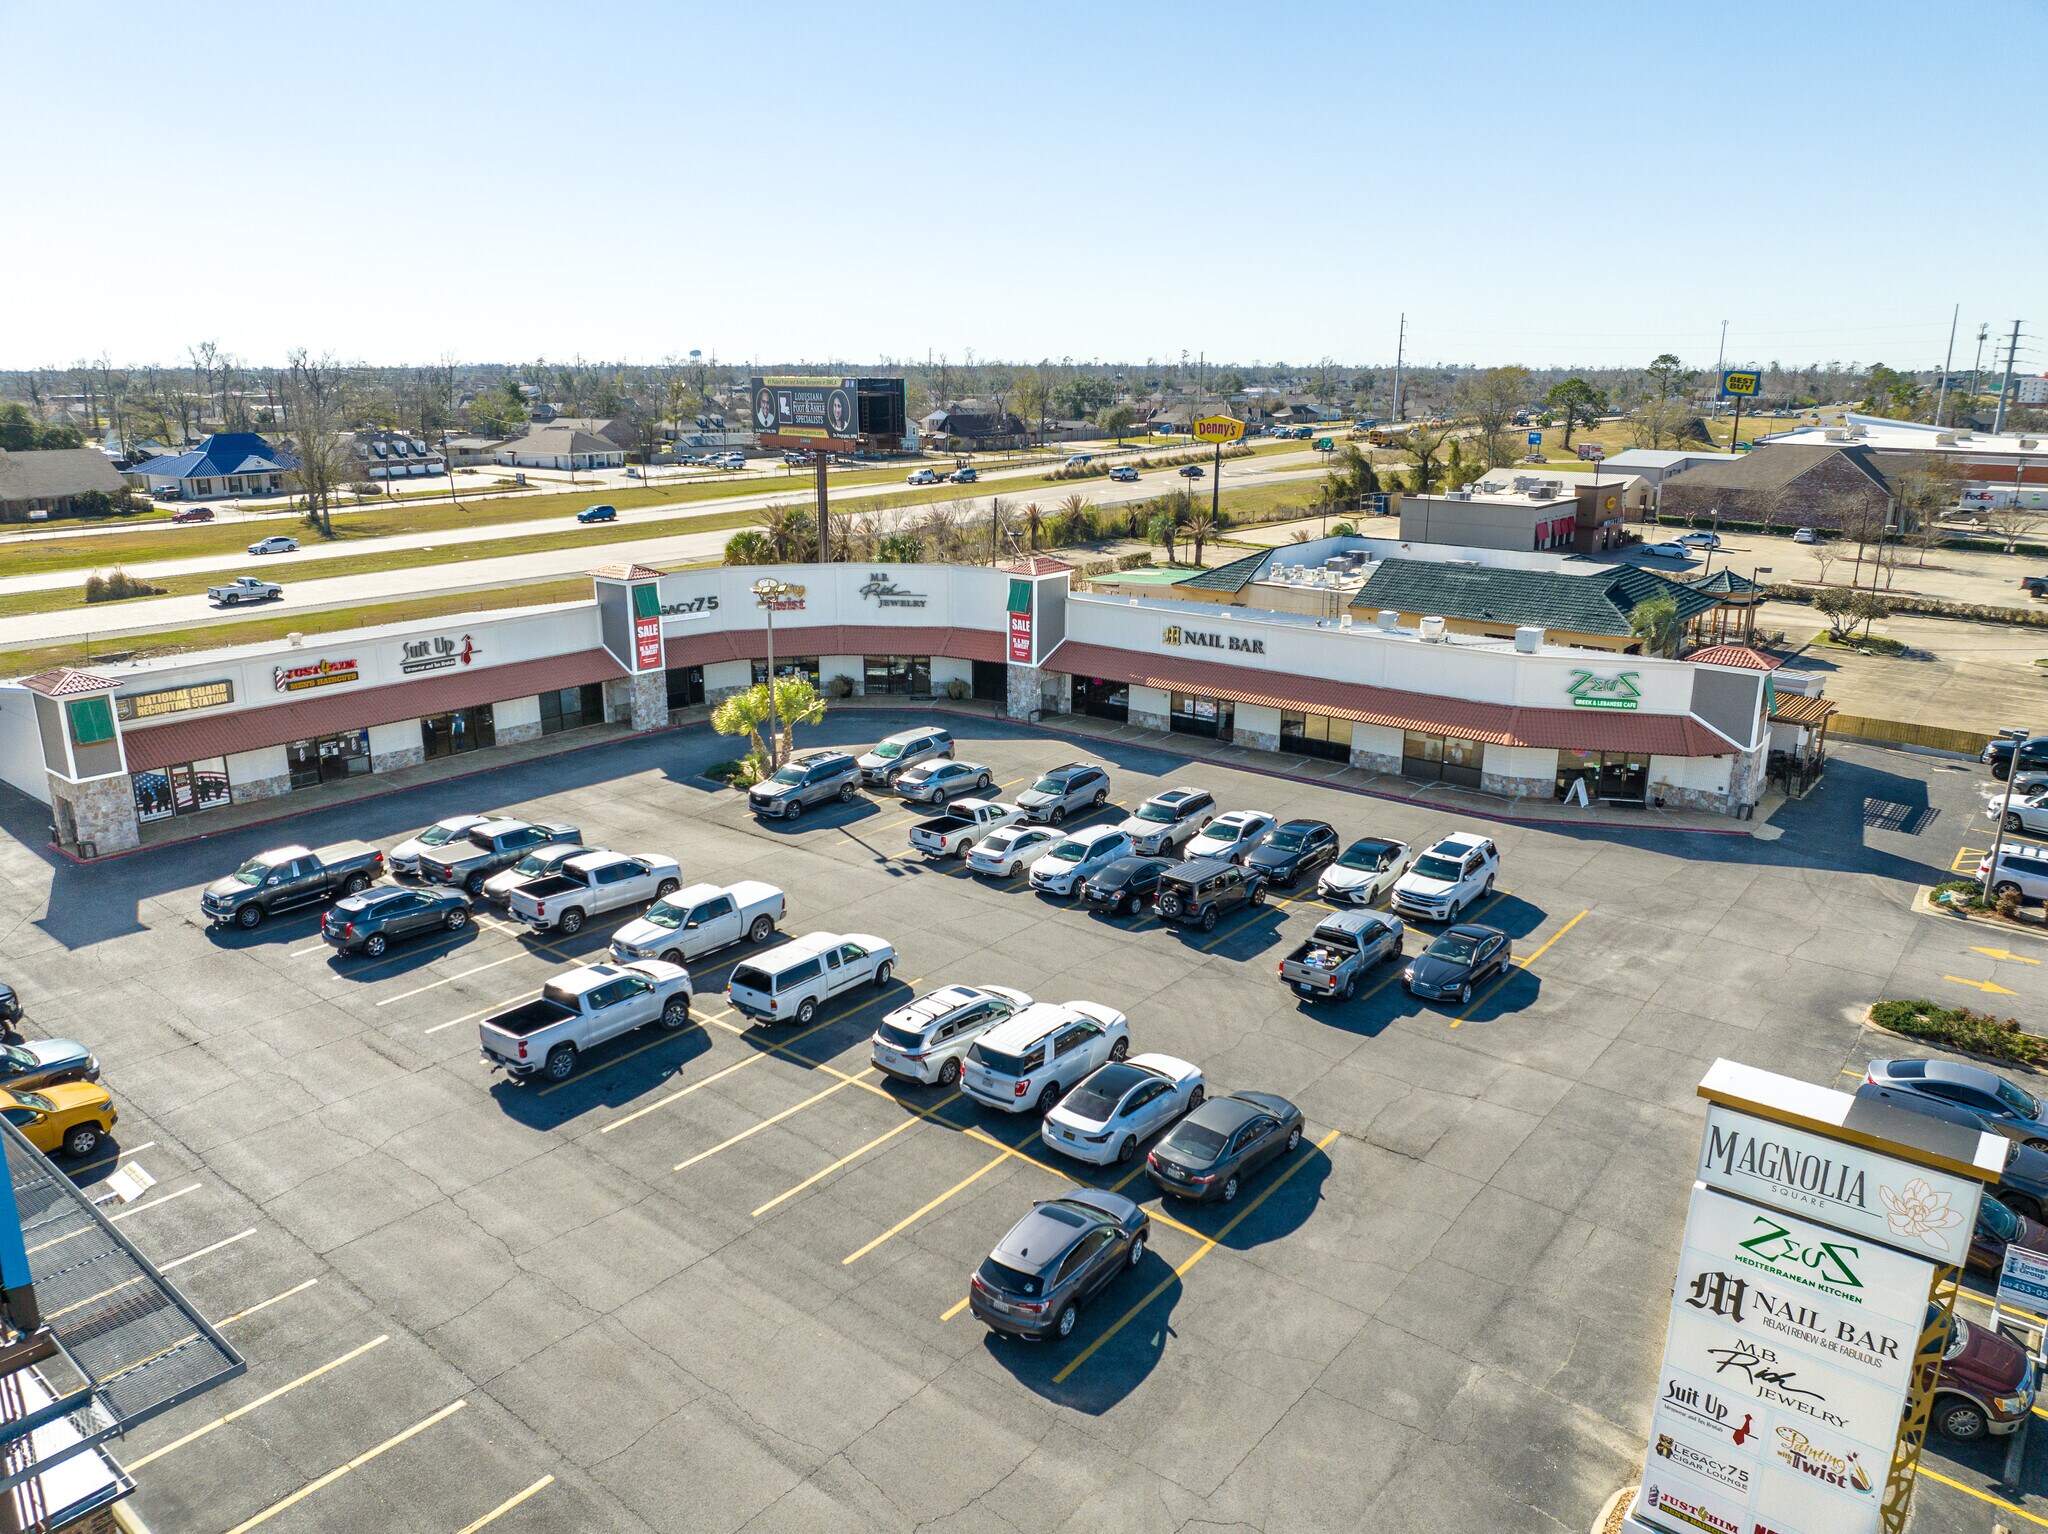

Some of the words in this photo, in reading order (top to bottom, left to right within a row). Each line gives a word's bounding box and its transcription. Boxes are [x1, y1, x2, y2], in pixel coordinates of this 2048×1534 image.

[1730, 376, 1755, 385] BEST
[1730, 383, 1751, 391] BUY
[793, 401, 805, 413] FOOT
[810, 403, 825, 413] ANKLE
[795, 393, 823, 401] LOUISIANA
[795, 415, 824, 424] SPECIALISTS
[1199, 422, 1237, 437] Denny's
[1965, 491, 1994, 501] FedEx
[859, 582, 911, 600] Rich
[878, 599, 927, 609] JEWELRY
[637, 623, 658, 638] SALE
[1012, 618, 1031, 632] SALE
[402, 641, 432, 662] Suit
[434, 636, 455, 656] Up
[1184, 631, 1225, 649] NAIL
[1228, 636, 1265, 654] BAR
[290, 680, 315, 690] MEN'S
[317, 673, 357, 686] HAIRCUTS
[135, 689, 190, 706] NATIONAL
[190, 683, 227, 698] GUARD
[137, 699, 191, 717] RECRUITING
[192, 693, 228, 708] STATION
[1705, 1125, 1867, 1208] MAGNOLIA
[1771, 1185, 1825, 1208] SQUARE
[1734, 1254, 1816, 1288] MEDITERRANEAN
[1817, 1283, 1863, 1304] KITCHEN
[2019, 1268, 2046, 1280] Group
[1752, 1290, 1826, 1333] NAIL
[1835, 1320, 1900, 1360] BAR
[1791, 1327, 1819, 1345] RENEW
[1820, 1338, 1828, 1348] &
[1828, 1340, 1839, 1352] BE
[1840, 1344, 1883, 1368] FABULOUS
[1707, 1349, 1826, 1401] Rich
[1664, 1379, 1700, 1408] Suit
[1705, 1393, 1728, 1420] Up
[1756, 1385, 1850, 1429] JEWELRY
[1776, 1426, 1846, 1474] Painting
[1777, 1450, 1793, 1461] with
[1672, 1452, 1703, 1471] CIGAR
[1706, 1468, 1749, 1491] LOUNGE
[1789, 1449, 1848, 1489] Twist
[1661, 1504, 1689, 1520] MEN'S
